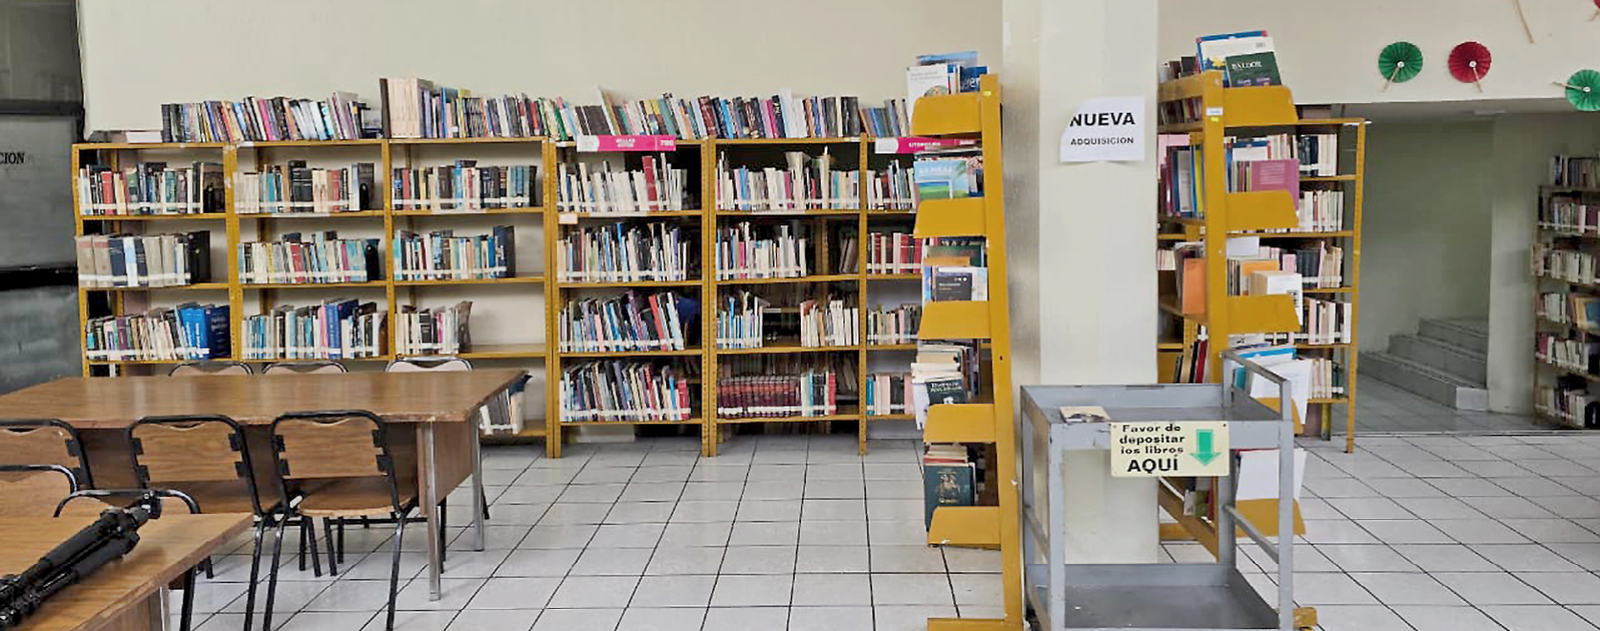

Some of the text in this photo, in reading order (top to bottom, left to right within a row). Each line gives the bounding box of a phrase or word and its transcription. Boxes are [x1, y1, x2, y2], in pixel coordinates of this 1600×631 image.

[1069, 112, 1136, 127] NUEVA
[1070, 137, 1134, 145] ADQUISICION
[1122, 423, 1181, 432] Favor de
[1119, 434, 1185, 445] depositar
[1145, 445, 1184, 454] libros
[1127, 454, 1178, 474] AQUÍ
